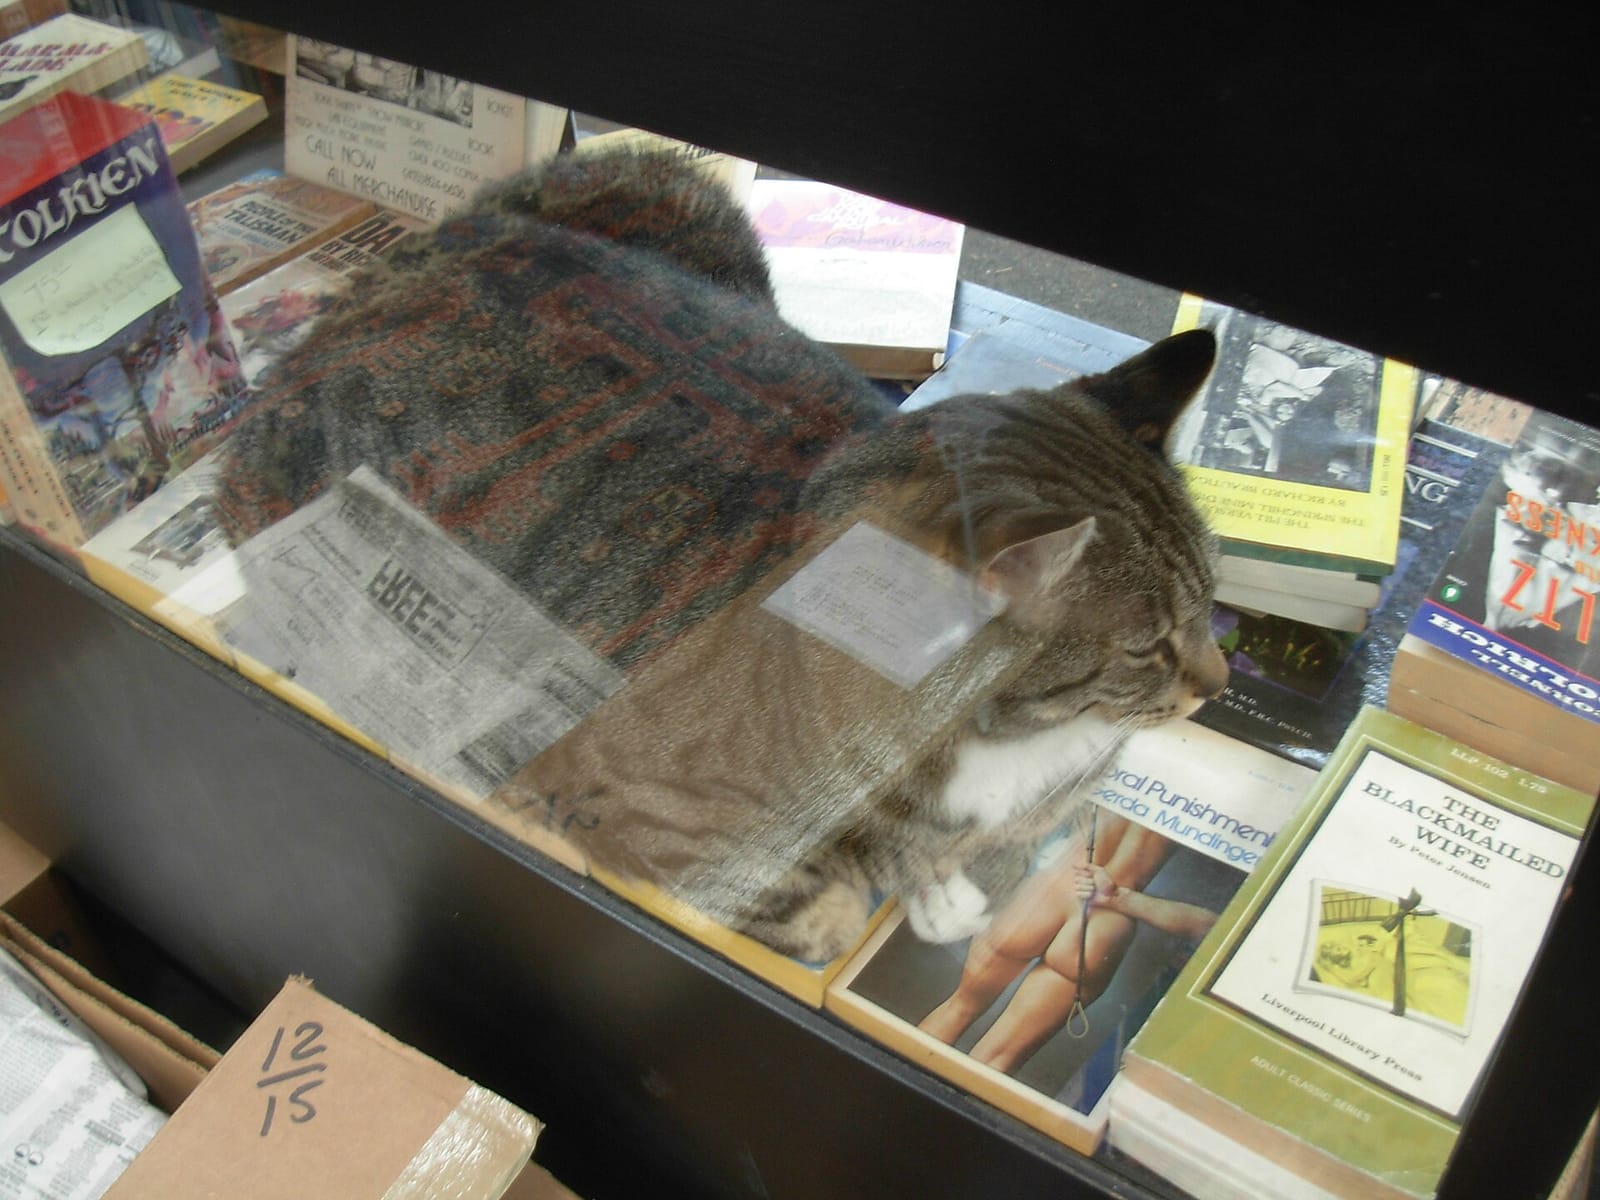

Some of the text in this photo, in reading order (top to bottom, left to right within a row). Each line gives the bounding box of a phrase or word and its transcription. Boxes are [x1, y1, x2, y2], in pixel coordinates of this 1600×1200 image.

[305, 135, 334, 161] CALL
[341, 144, 377, 171] NOW
[1428, 613, 1600, 703] OLRICH
[1471, 649, 1600, 717] ORNELL
[1091, 787, 1151, 817] erda
[1144, 779, 1278, 848] Punishment
[1362, 780, 1565, 880] BLACKMAILED
[1443, 796, 1501, 831] THE
[1387, 836, 1492, 890] By Peter Jensen
[1415, 825, 1491, 870] WIFE
[262, 1021, 327, 1072] 12
[1260, 993, 1423, 1082] Liverpool Library Press
[260, 1079, 324, 1137] 15
[1250, 1055, 1286, 1077] ADULT
[1334, 1093, 1372, 1123] SERIES
